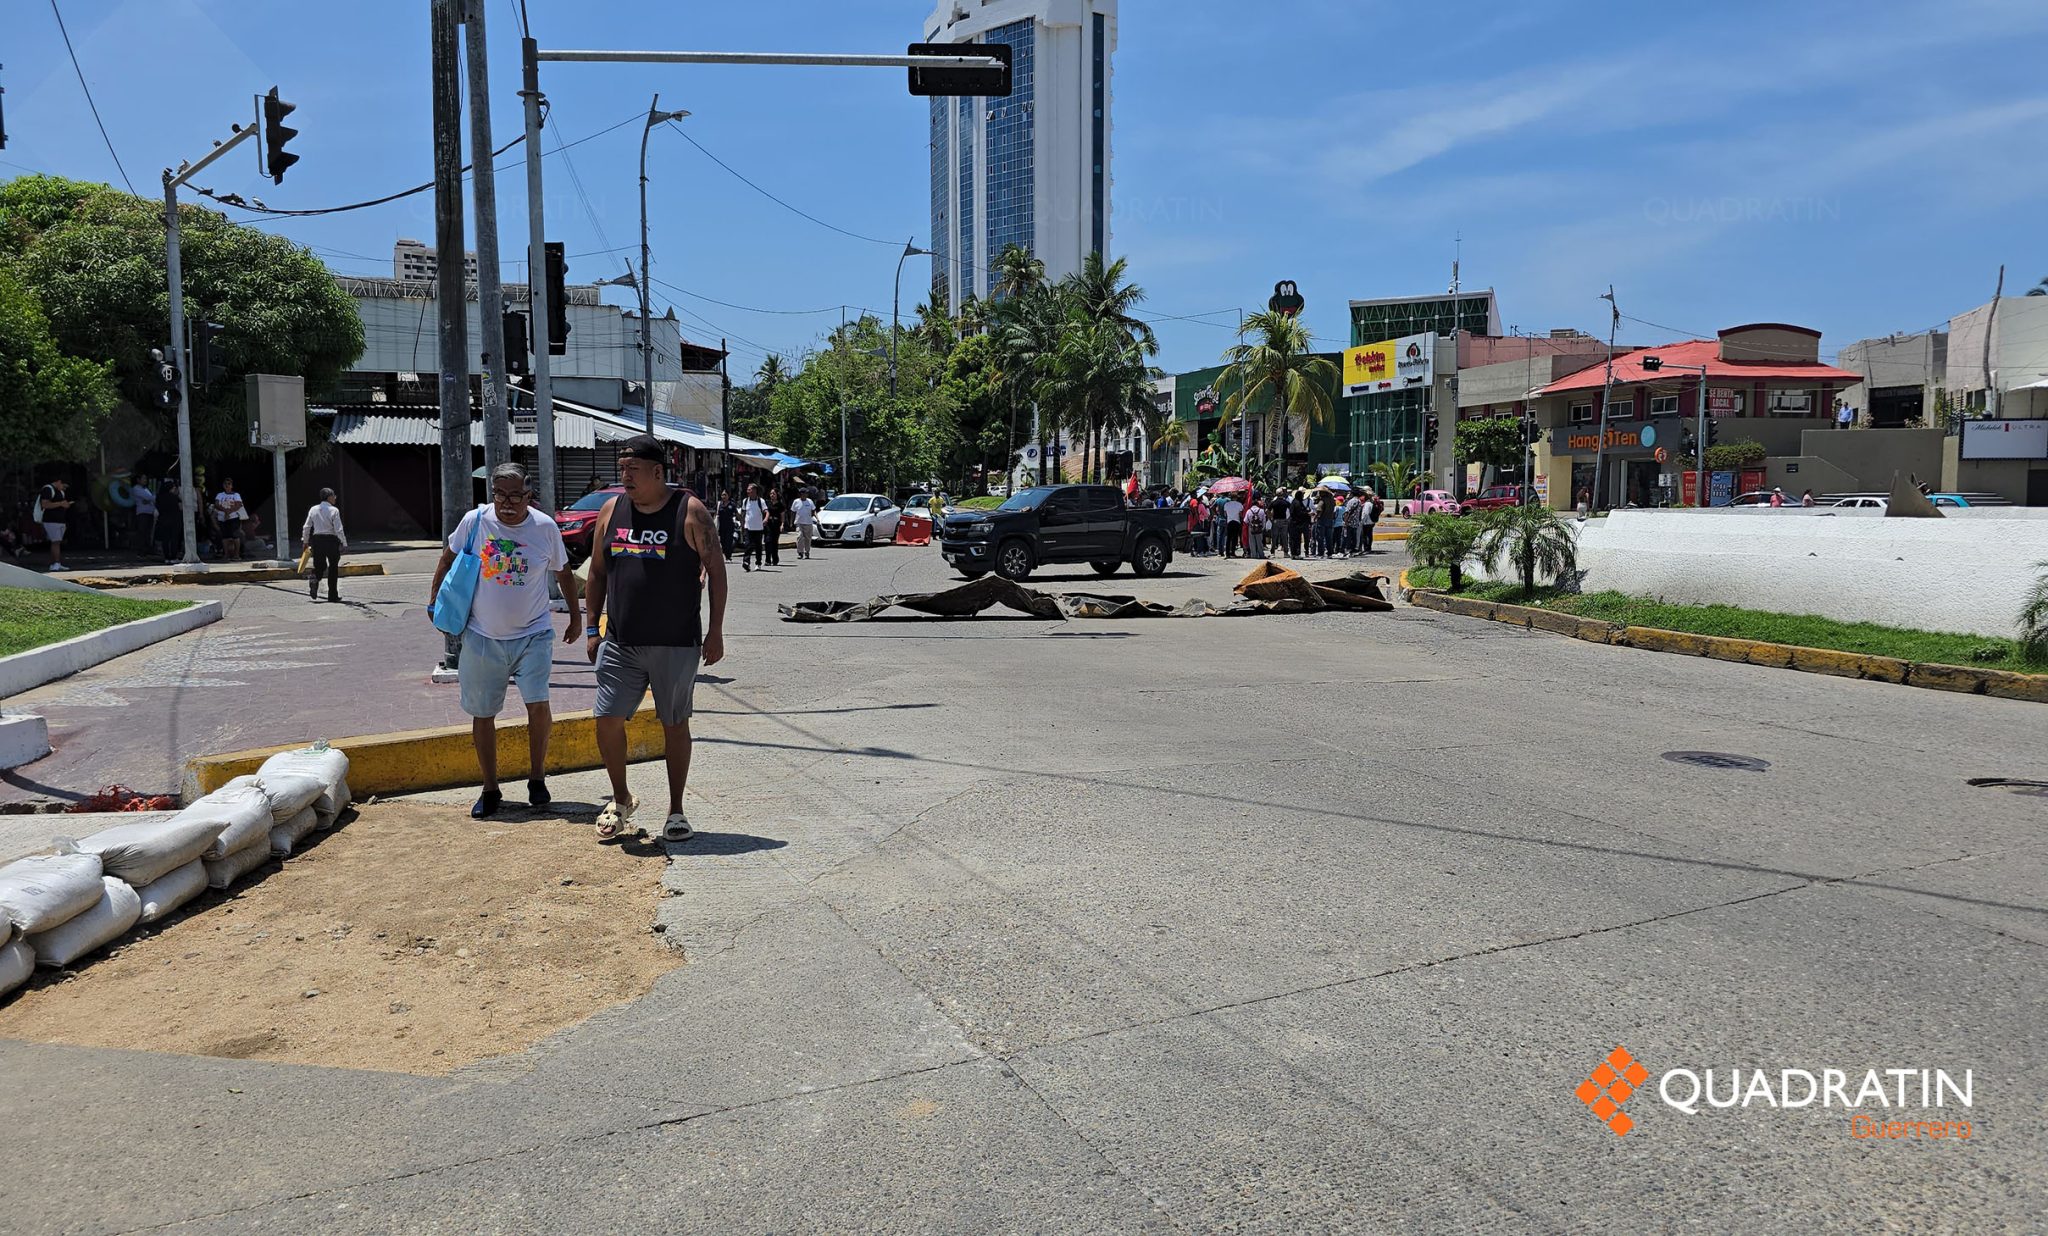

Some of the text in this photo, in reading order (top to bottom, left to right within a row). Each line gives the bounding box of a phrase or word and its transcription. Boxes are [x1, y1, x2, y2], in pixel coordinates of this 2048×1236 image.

[1717, 388, 1734, 398] RENTA
[1712, 398, 1730, 407] LOCAL
[1568, 431, 1638, 452] Hang Ten
[627, 529, 668, 545] LRG
